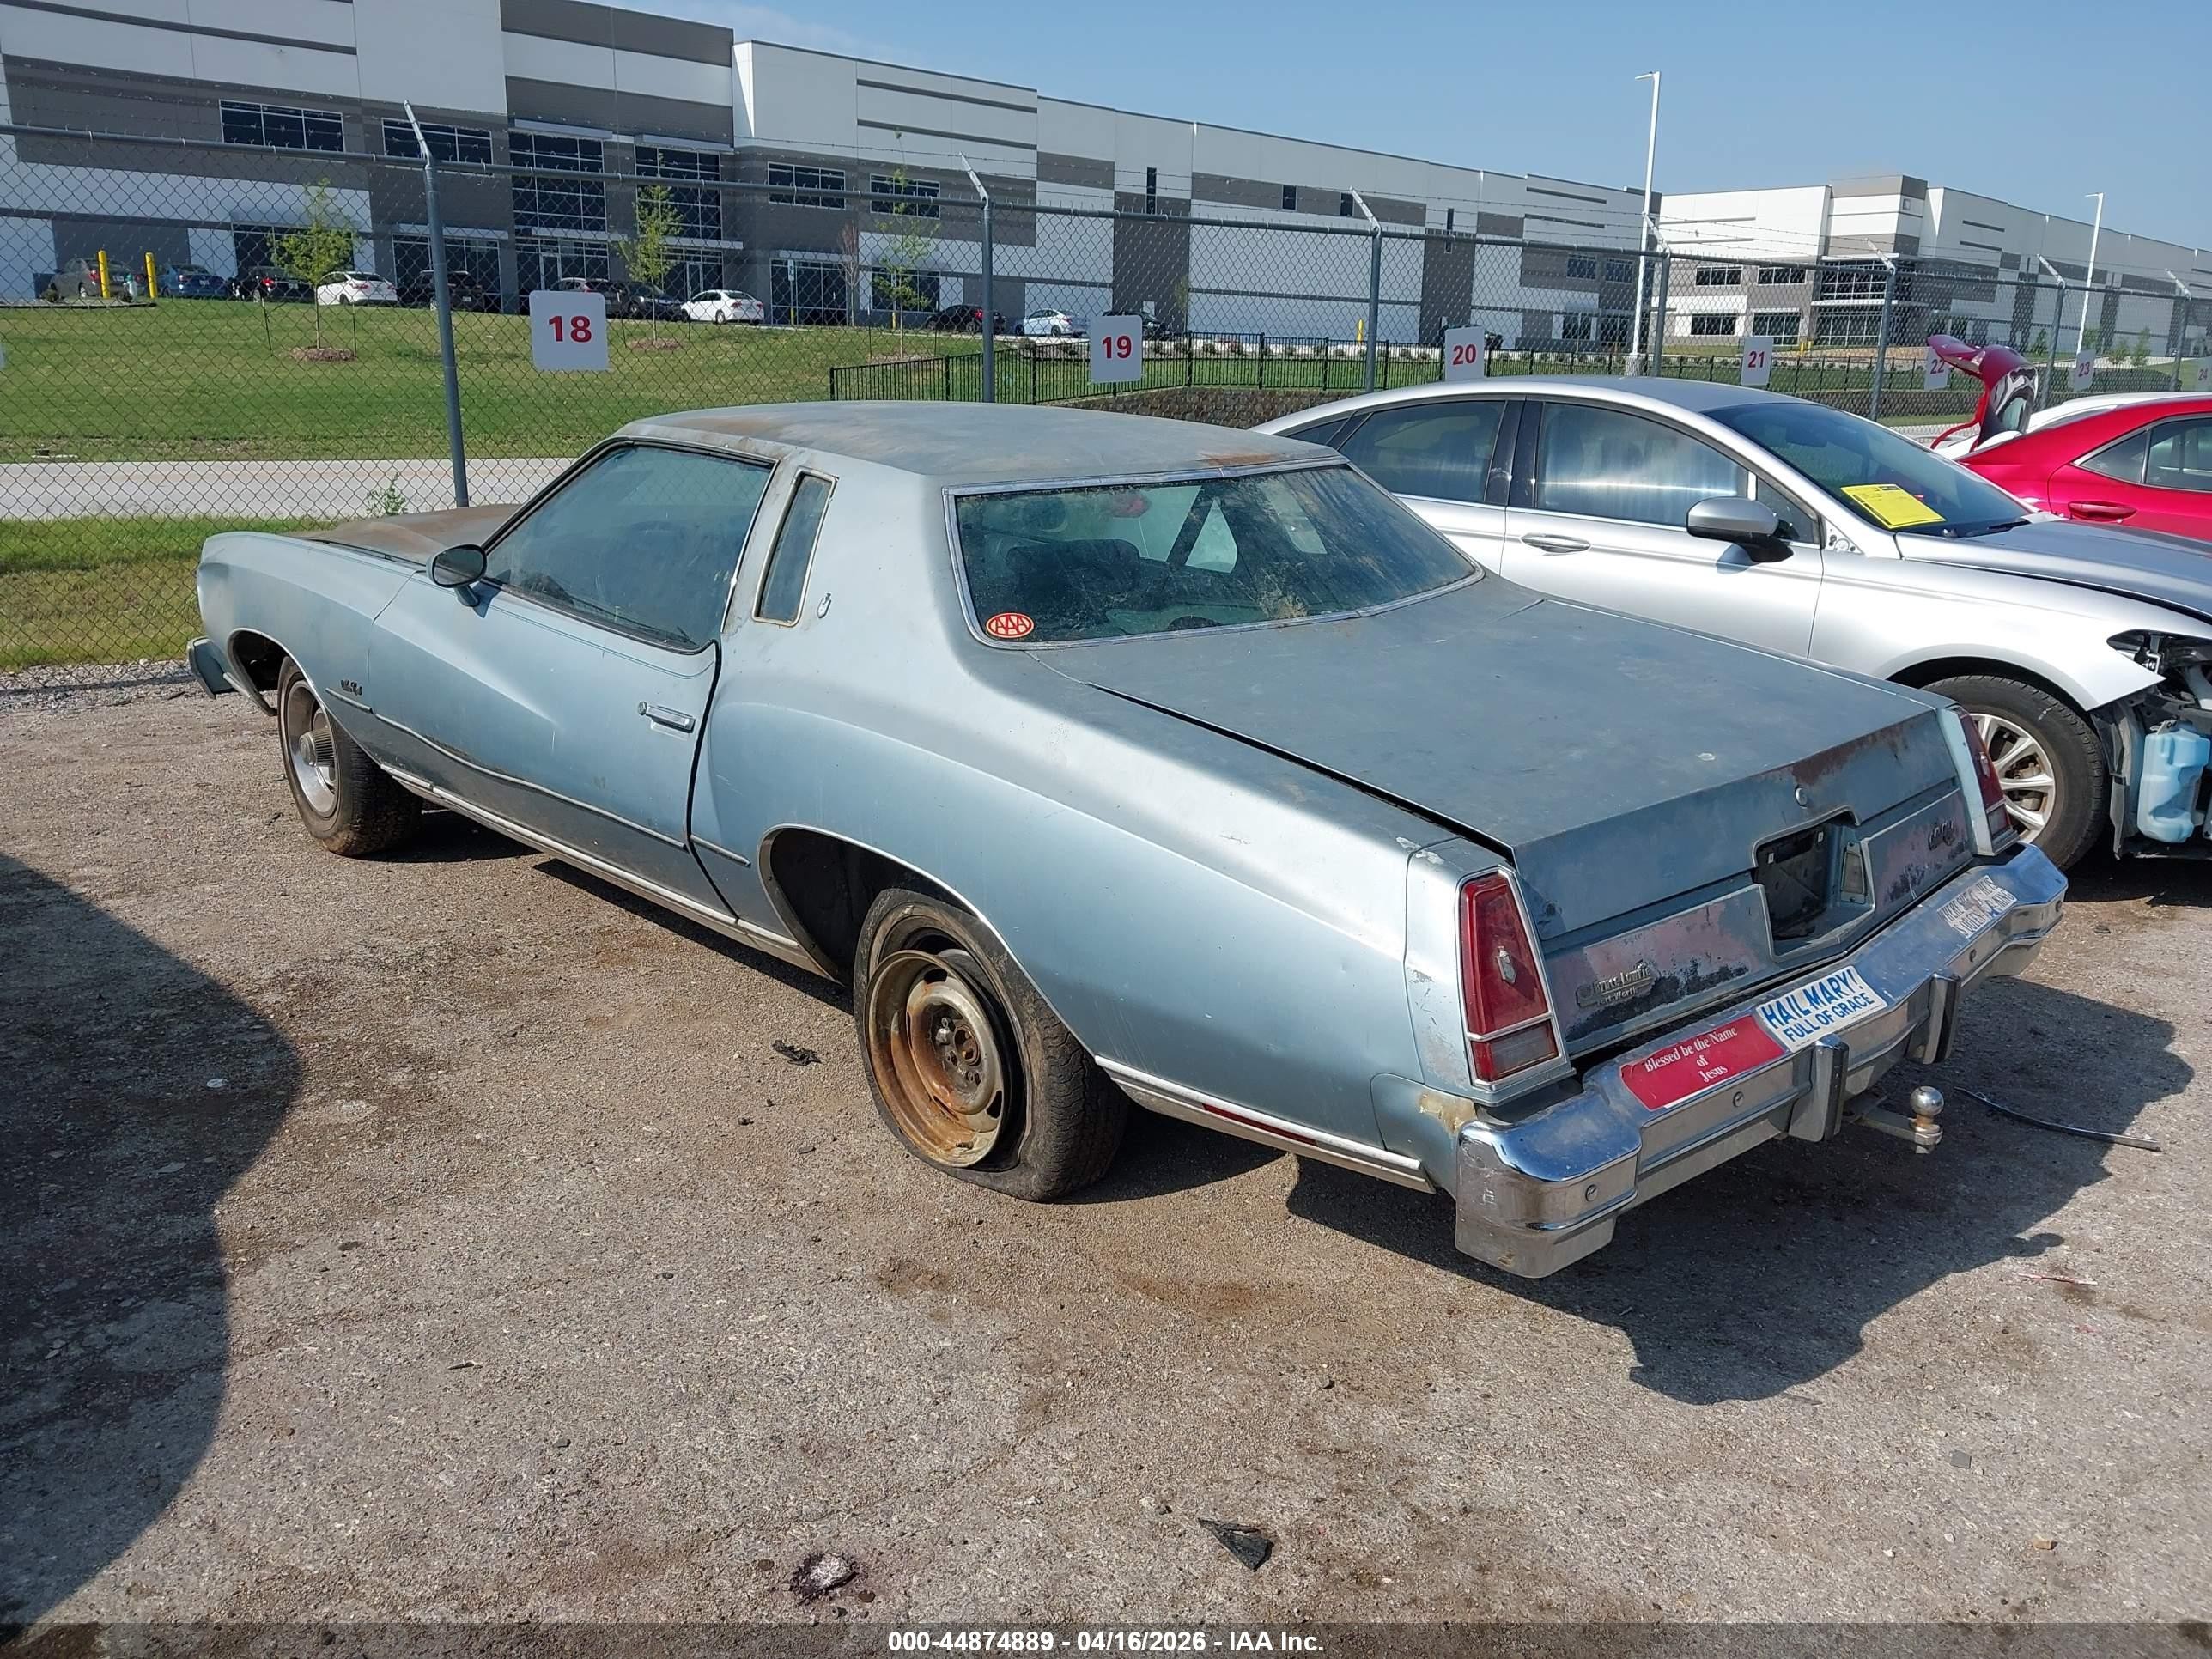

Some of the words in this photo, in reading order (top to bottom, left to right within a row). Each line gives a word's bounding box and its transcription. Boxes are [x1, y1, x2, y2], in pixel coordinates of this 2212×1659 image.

[549, 315, 592, 343] 18
[1103, 335, 1132, 359] 19
[1453, 344, 1477, 365] 20
[1748, 351, 1765, 368] 21
[1930, 359, 1944, 374] 22
[2079, 362, 2090, 377] 23
[2198, 368, 2208, 380] 24
[993, 615, 1030, 635] AAA
[1761, 994, 1812, 1029] HAIL
[1803, 969, 1863, 1010] MARY!
[1783, 1019, 1820, 1042] FULL
[1815, 1010, 1834, 1025] OF
[1832, 993, 1875, 1018] GRACE
[1644, 1049, 1680, 1072] Blessed
[1680, 1045, 1694, 1057] be
[1693, 1038, 1711, 1052] the
[1709, 1027, 1738, 1046] Name
[1696, 1054, 1709, 1066] of
[1698, 1064, 1728, 1083] Jesus
